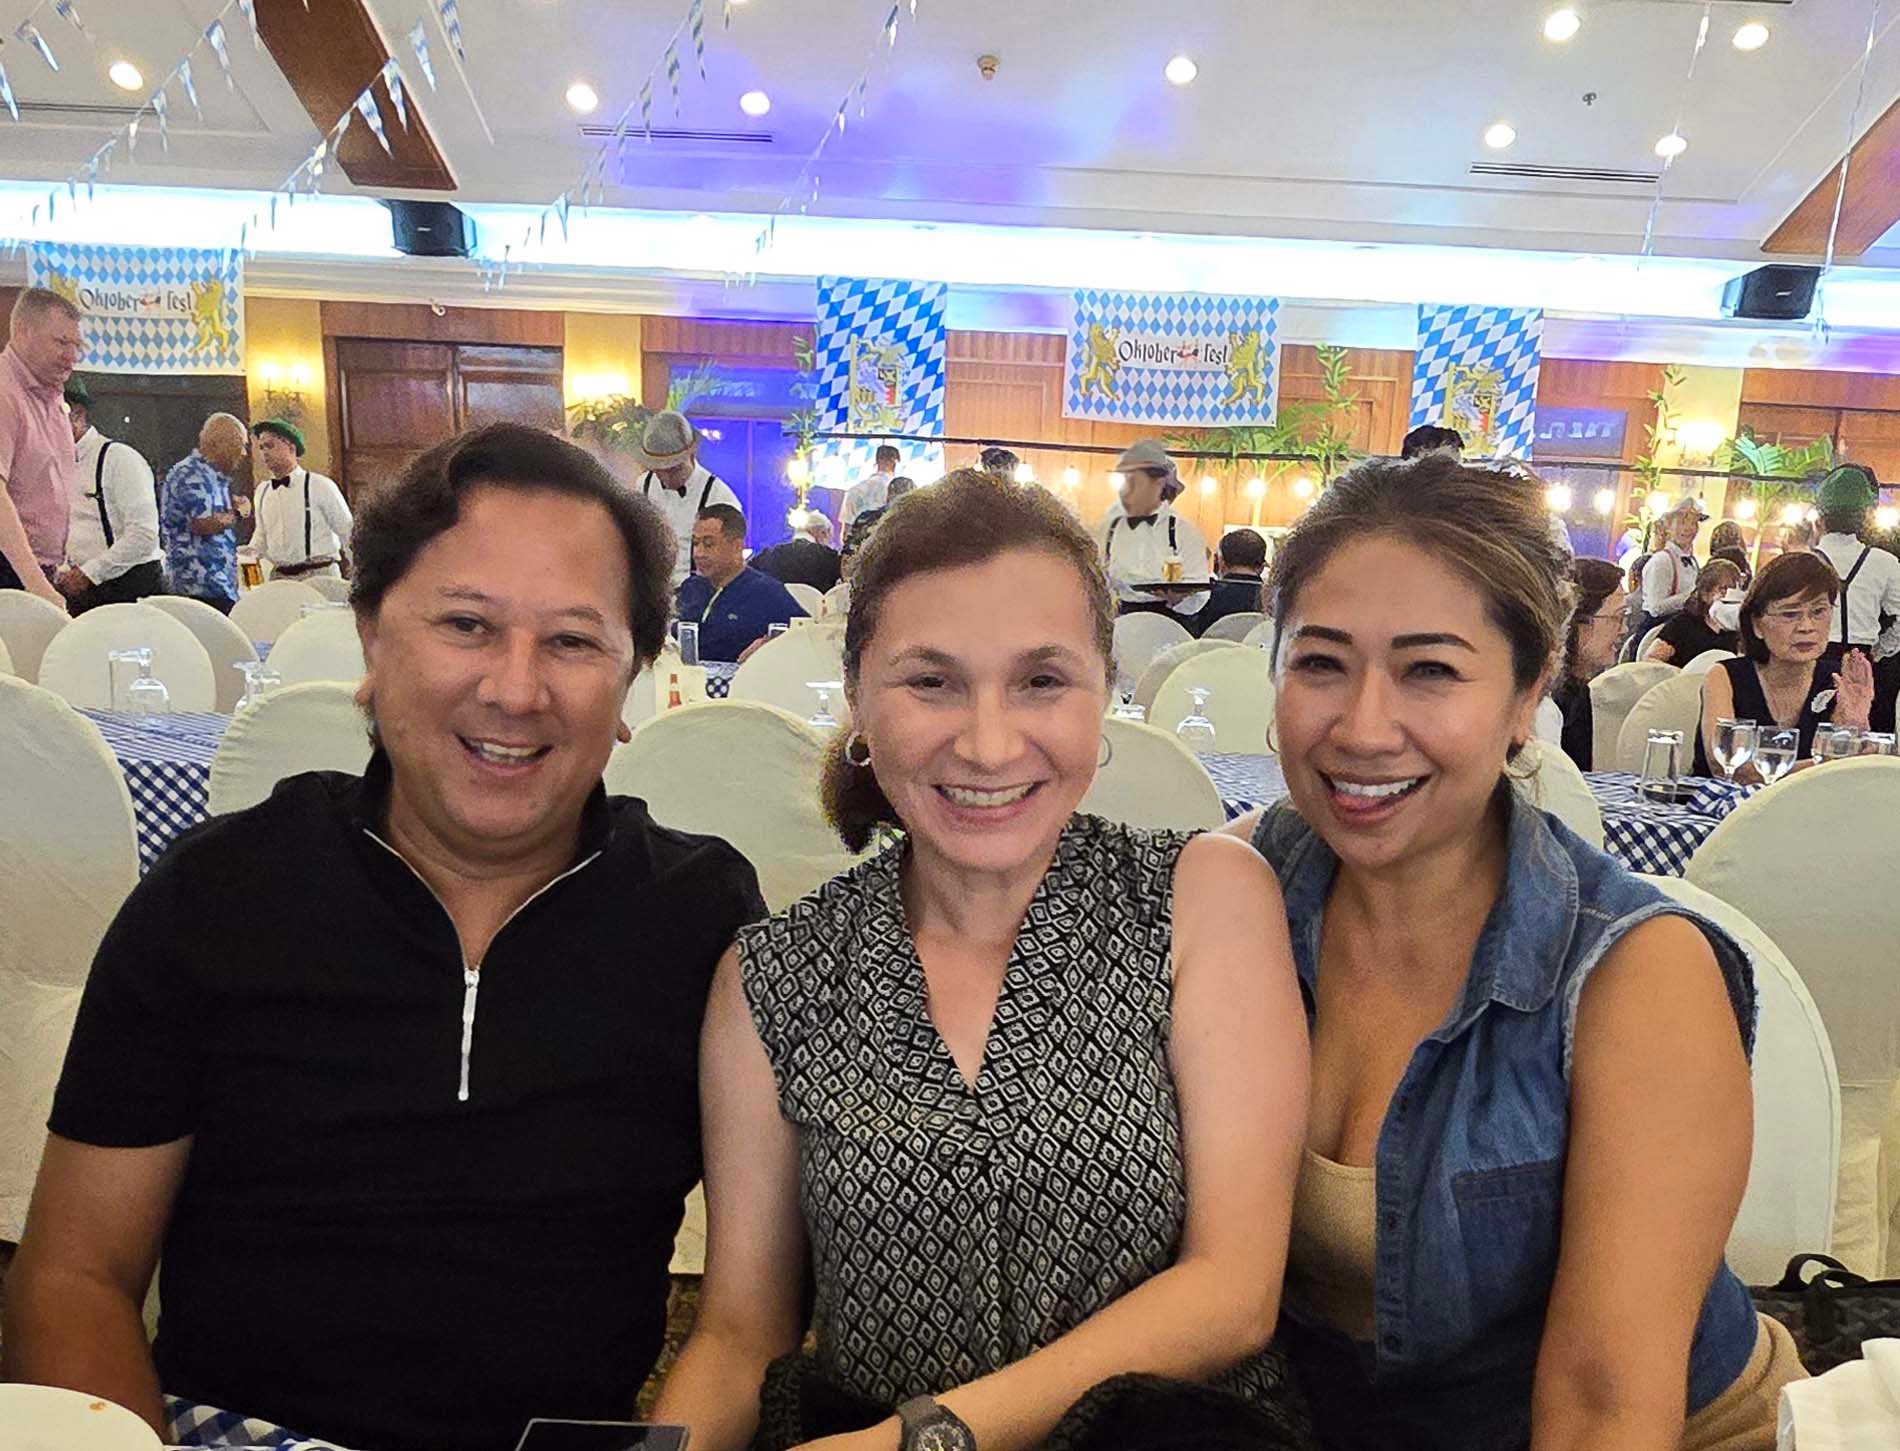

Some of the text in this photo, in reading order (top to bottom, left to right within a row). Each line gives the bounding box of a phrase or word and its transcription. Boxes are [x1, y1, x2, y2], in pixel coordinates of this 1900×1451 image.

[78, 288, 192, 312] Oktober fest
[1118, 339, 1228, 366] Oktober fest
